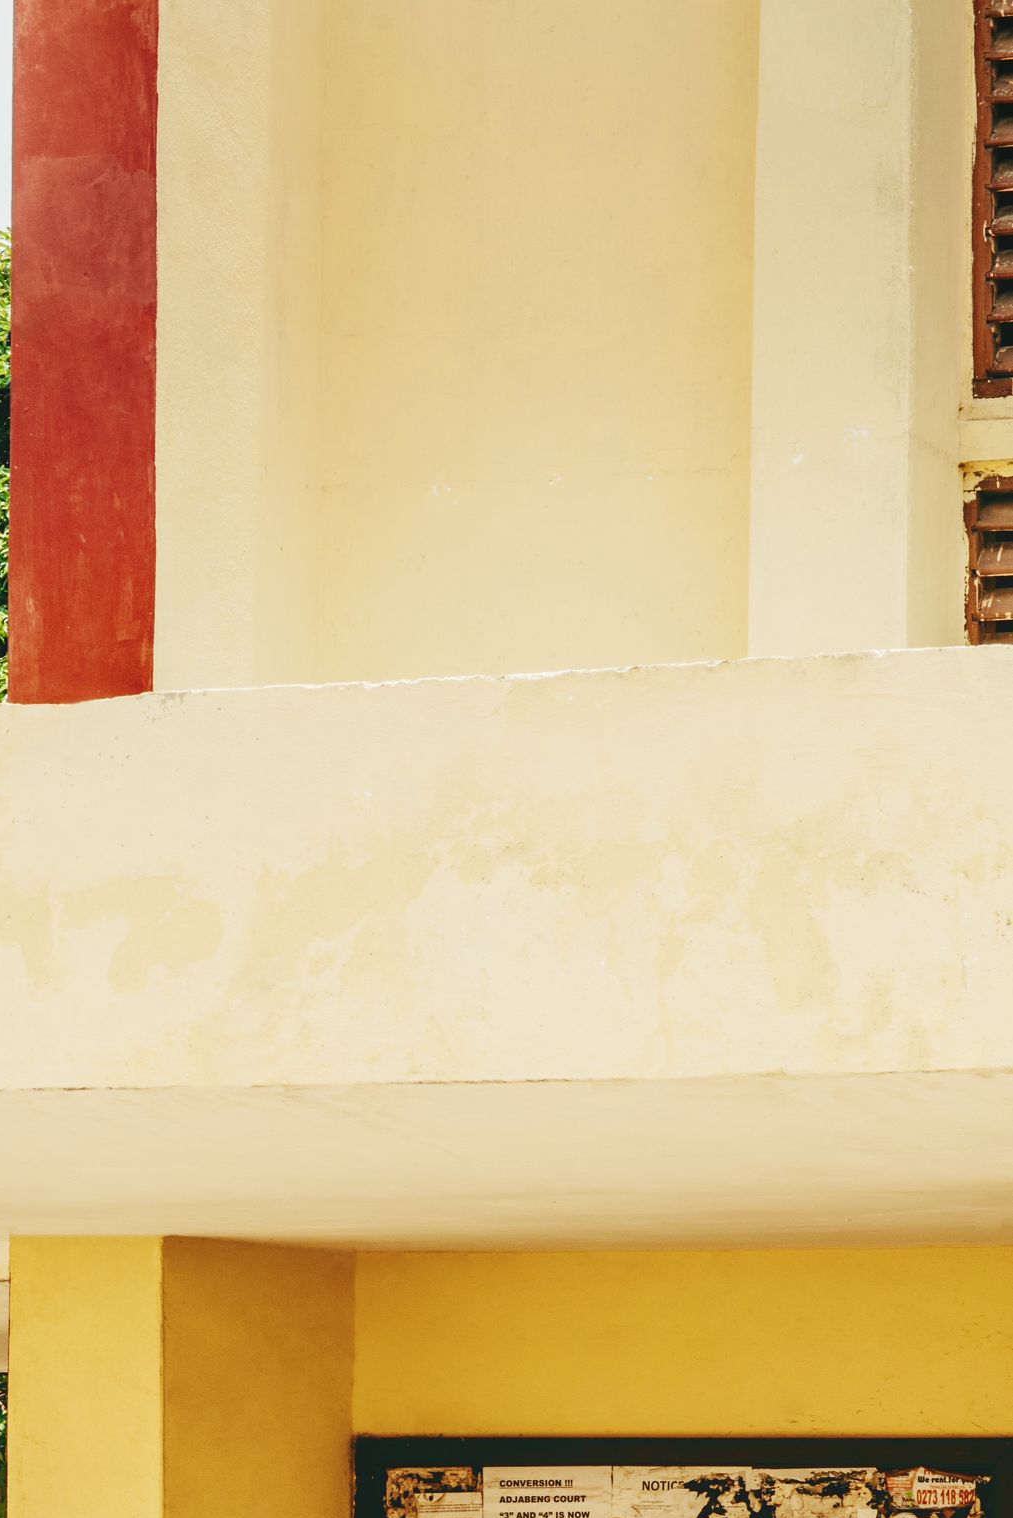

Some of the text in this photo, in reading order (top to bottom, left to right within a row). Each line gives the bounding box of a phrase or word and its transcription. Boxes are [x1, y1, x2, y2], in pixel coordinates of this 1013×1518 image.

[499, 1479, 573, 1489] CONVERSION !!!
[499, 1495, 587, 1504] ADJABENG COURT
[916, 1489, 975, 1505] 0273 118 582
[538, 1511, 553, 1518] “4”
[555, 1511, 565, 1518] IS
[567, 1511, 590, 1518] NOW
